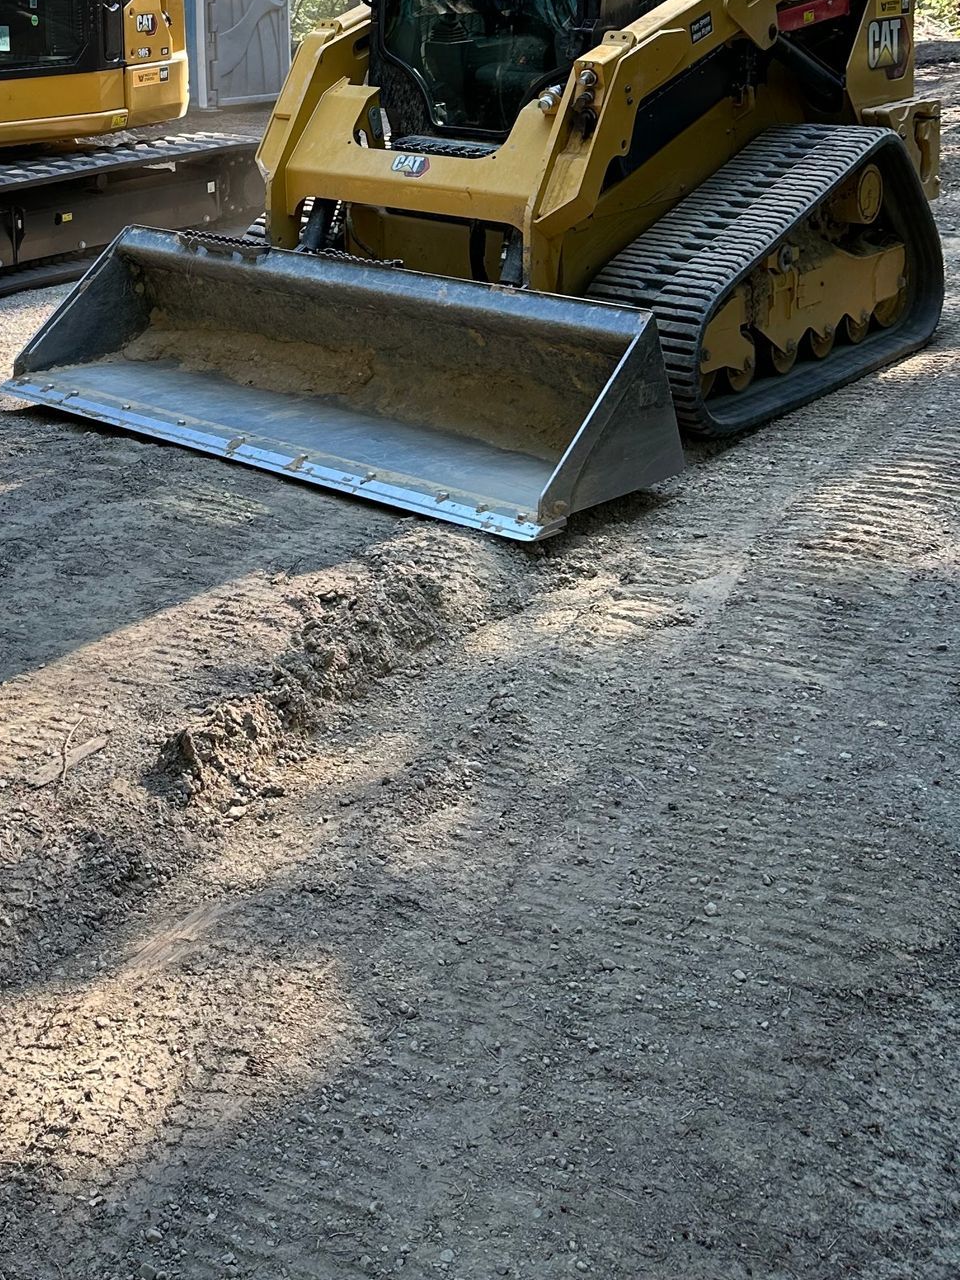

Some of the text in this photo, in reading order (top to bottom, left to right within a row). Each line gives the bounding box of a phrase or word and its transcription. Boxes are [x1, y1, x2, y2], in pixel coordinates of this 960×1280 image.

[137, 14, 153, 32] CAT
[137, 47, 149, 57] 305
[869, 19, 901, 69] CAT
[392, 154, 425, 173] CAT
